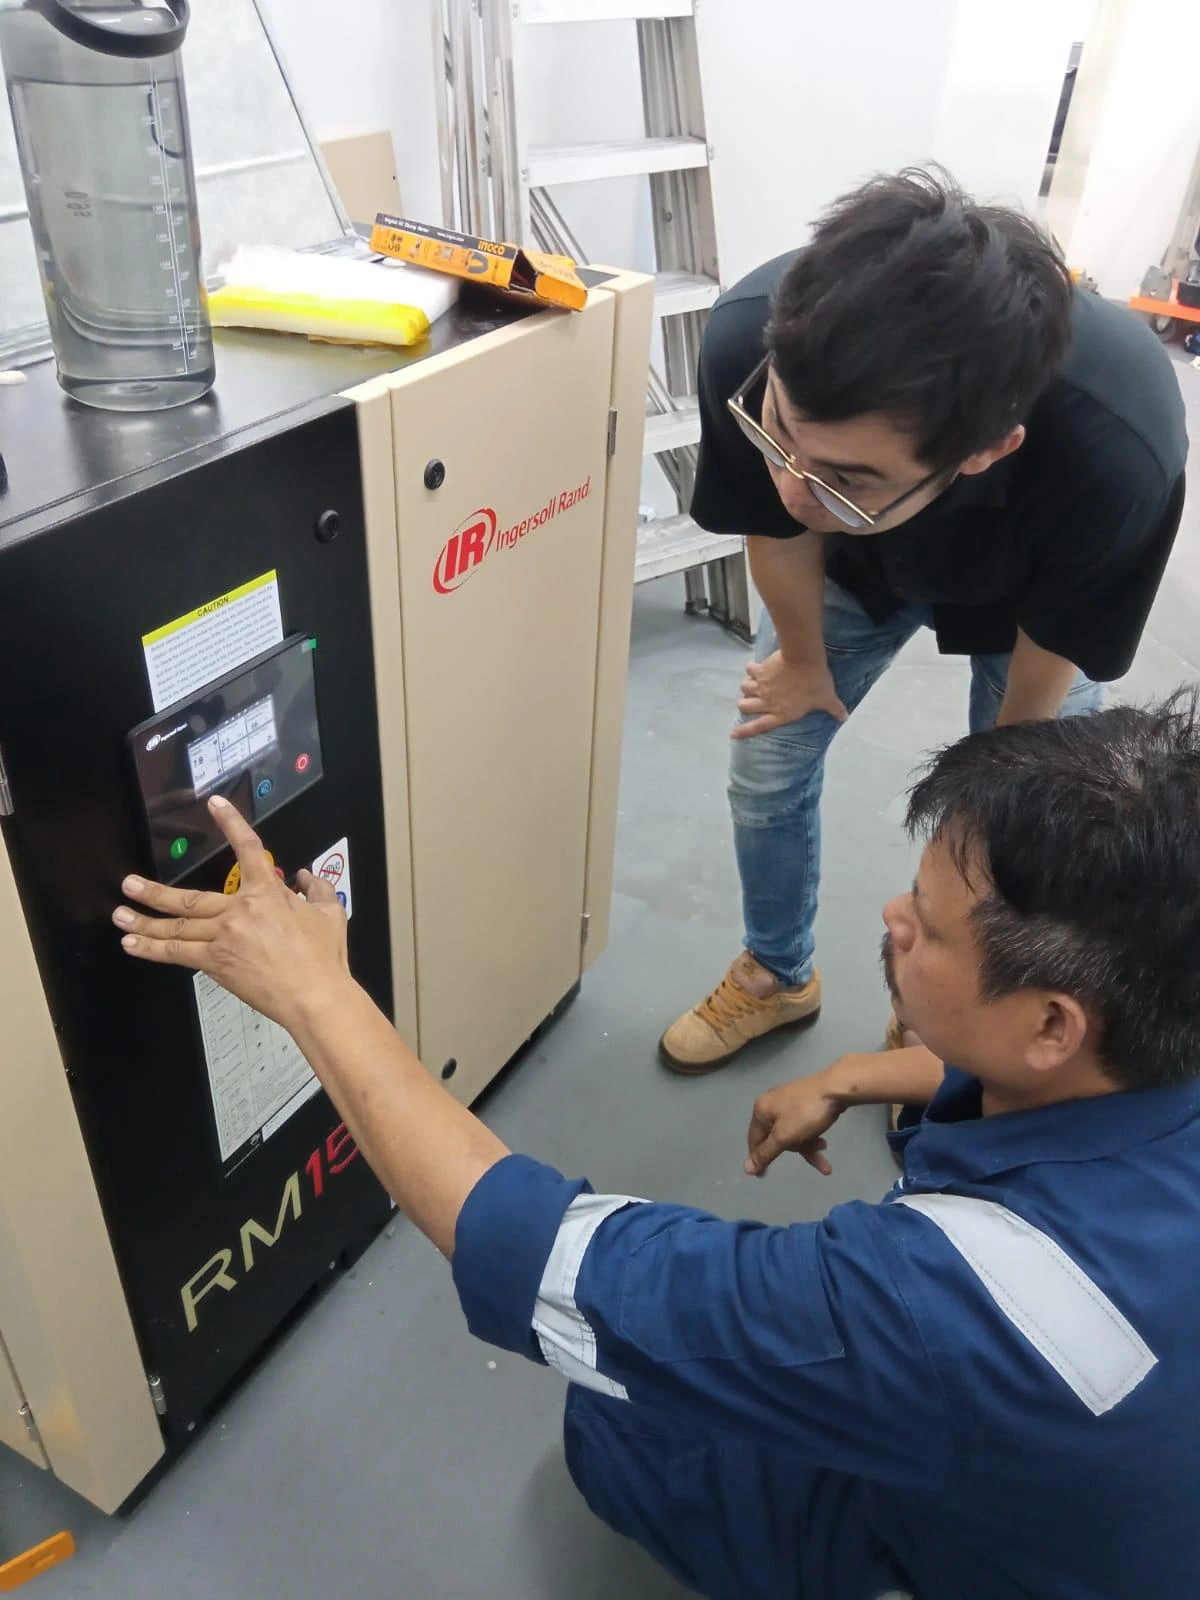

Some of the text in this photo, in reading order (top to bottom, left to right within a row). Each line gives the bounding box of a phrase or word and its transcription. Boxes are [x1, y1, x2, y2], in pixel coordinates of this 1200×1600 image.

[478, 240, 505, 255] INGCO
[496, 475, 592, 552] Ingersoll Rand
[443, 521, 487, 583] IR
[197, 595, 229, 617] CAUTION
